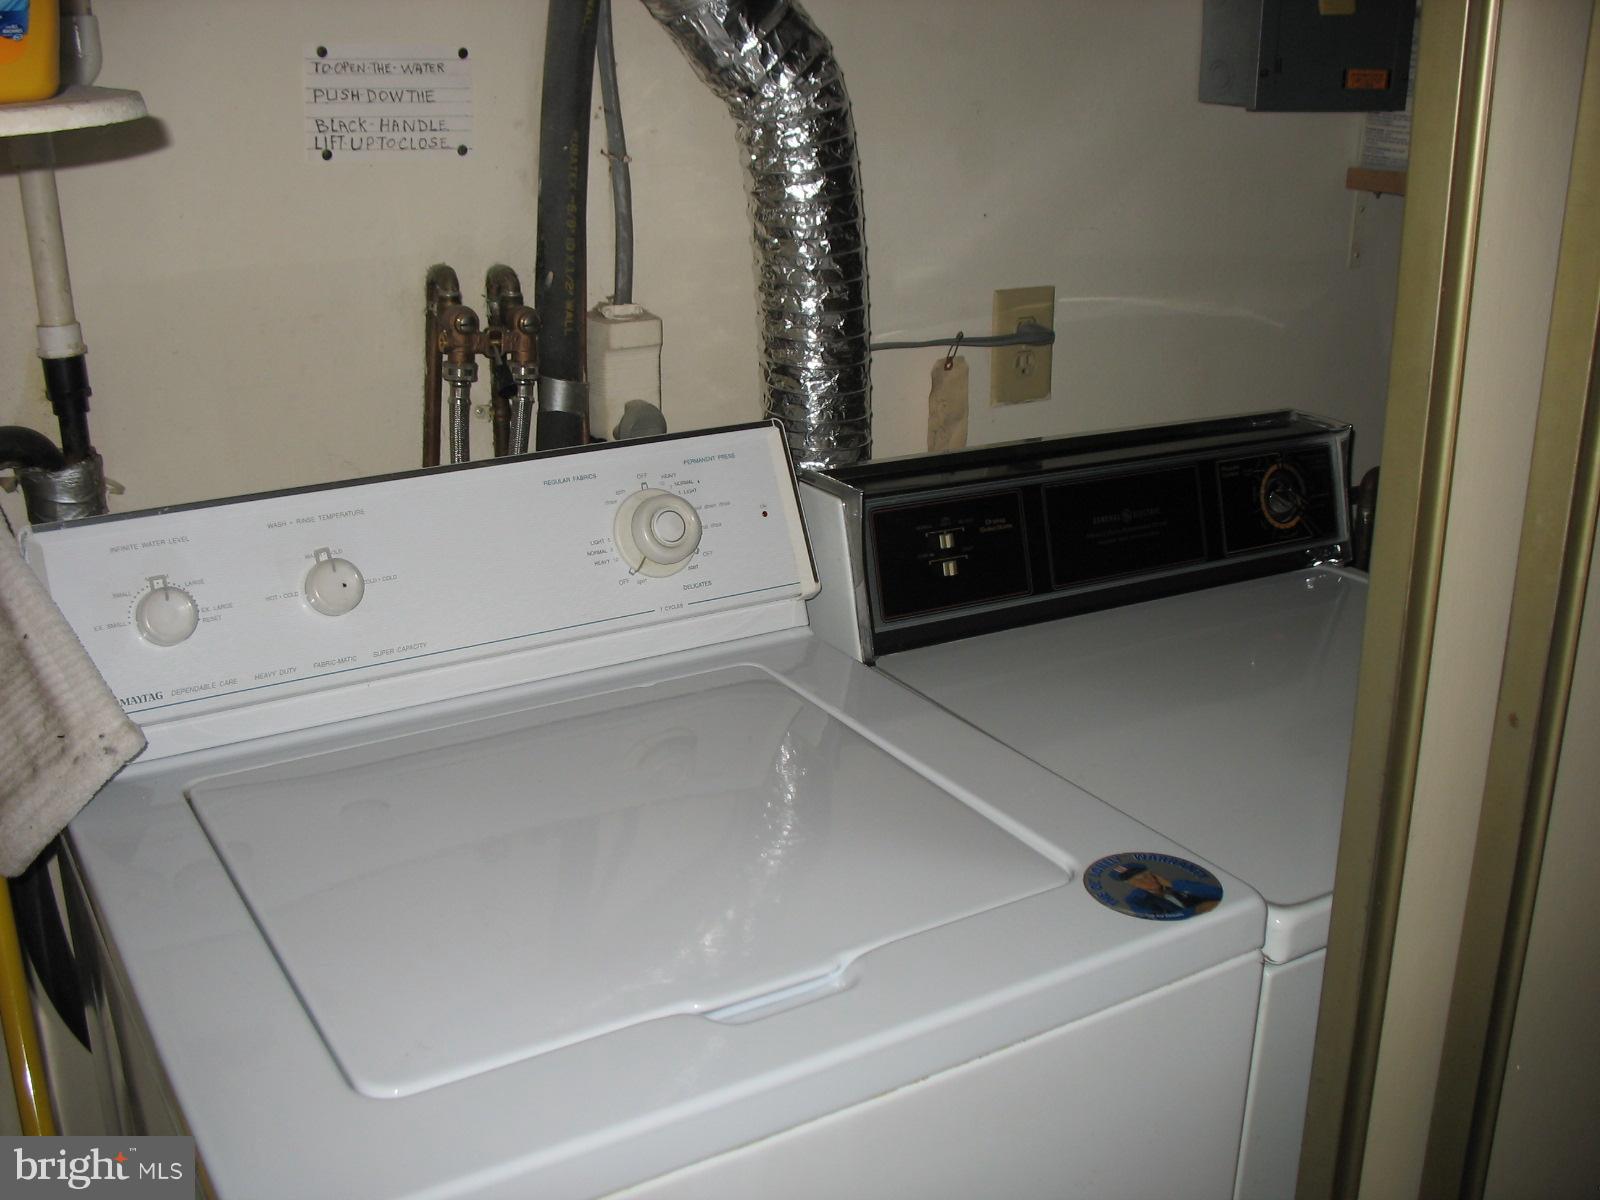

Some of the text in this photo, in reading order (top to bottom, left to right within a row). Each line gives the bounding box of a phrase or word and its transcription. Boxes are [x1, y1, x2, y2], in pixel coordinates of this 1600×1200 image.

[401, 62, 445, 75] WATER
[313, 88, 360, 102] PUSH
[315, 117, 449, 134] BLACK HANDLE
[314, 135, 345, 150] LIFT
[399, 136, 449, 150] CLOSE
[543, 477, 571, 486] REGULAR
[267, 521, 287, 529] WASH
[319, 508, 365, 521] TEMPERATURE
[142, 539, 166, 548] WATER
[168, 536, 190, 544] LEVEL
[682, 580, 712, 591] DELICATES
[120, 691, 164, 707] MAYTAG
[171, 682, 217, 697] DEPENDABLE
[220, 678, 238, 688] CARE
[254, 670, 276, 680] HEAVY
[279, 666, 297, 676] DUTY
[373, 648, 395, 658] SUPER
[398, 642, 428, 652] CAPACITY
